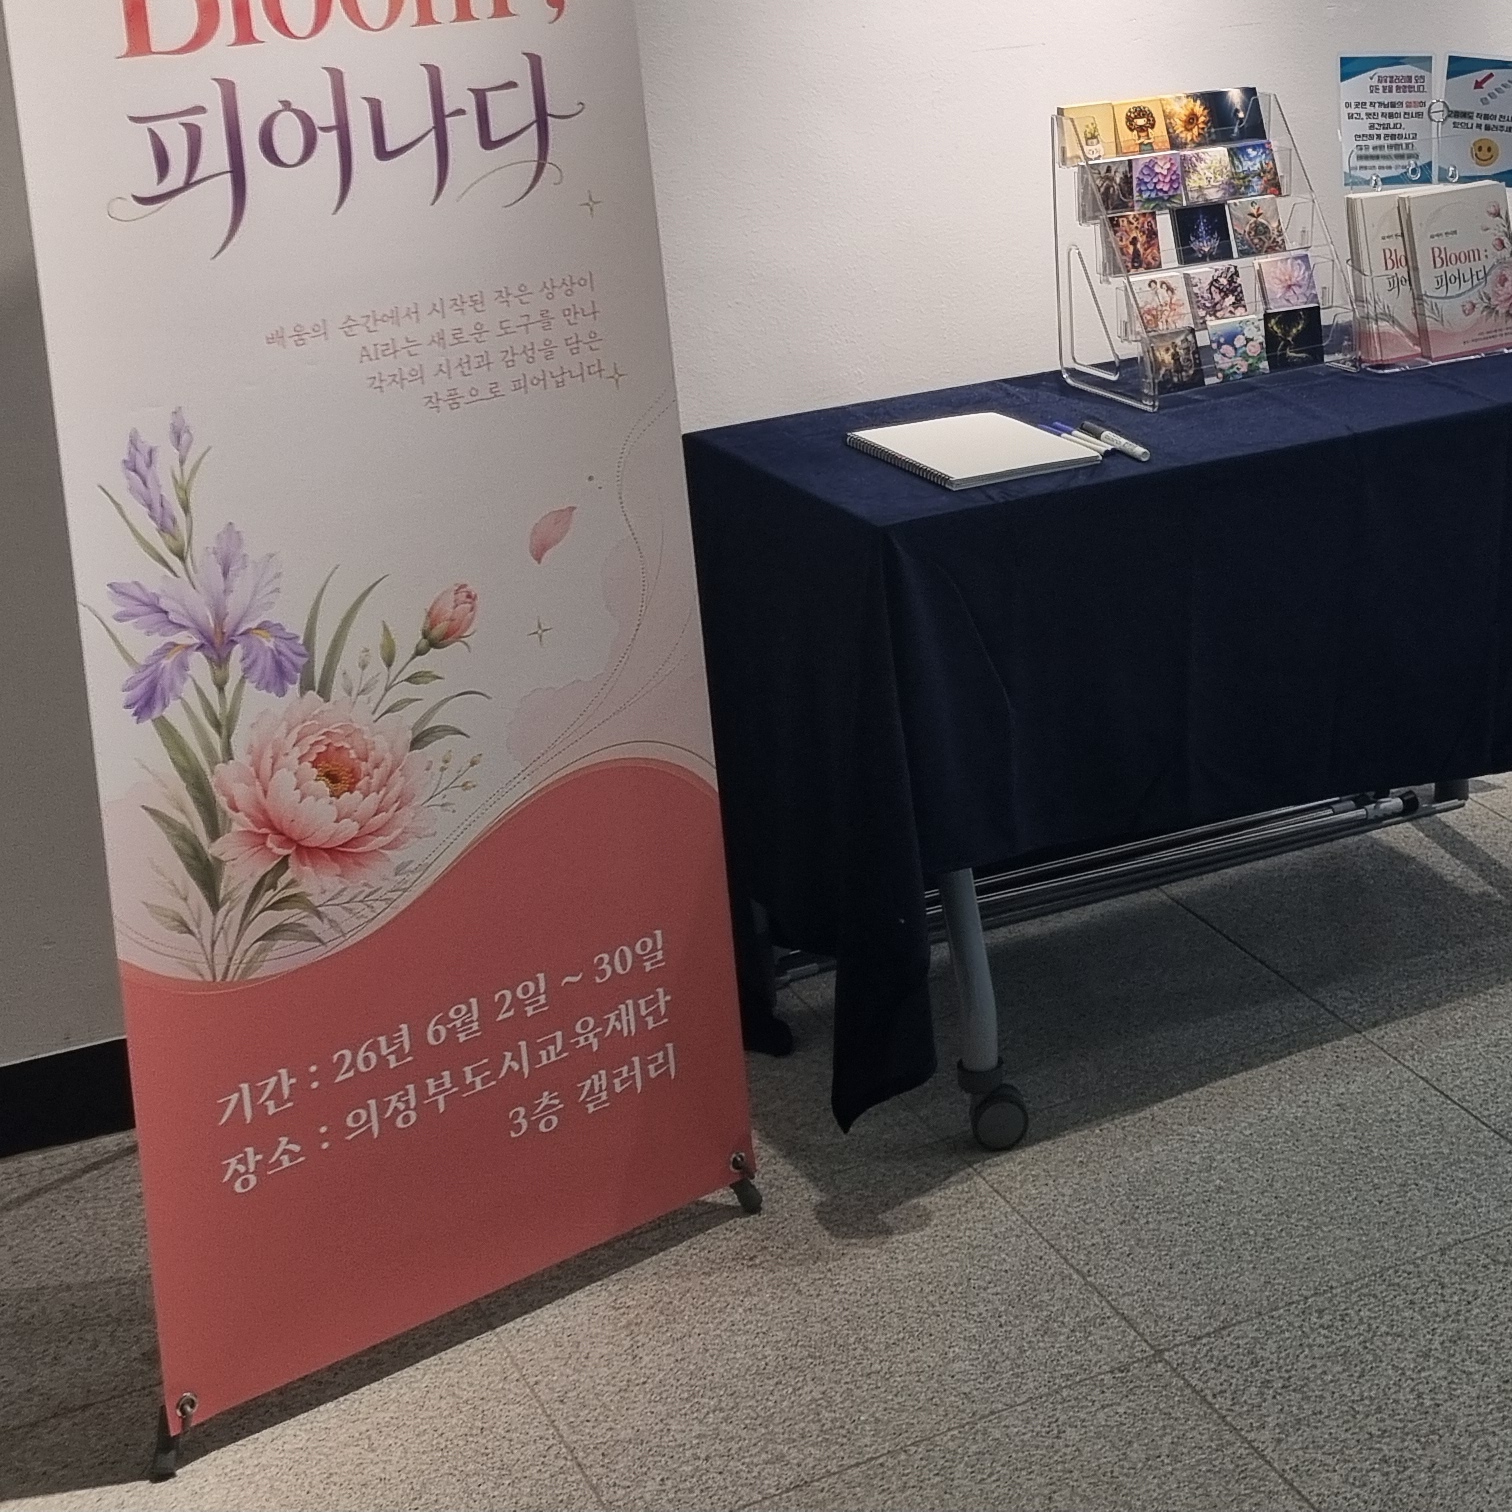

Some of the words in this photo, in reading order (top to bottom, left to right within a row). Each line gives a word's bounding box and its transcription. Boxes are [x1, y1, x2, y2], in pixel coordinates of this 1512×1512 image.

[1344, 101, 1352, 109] 이
[1381, 111, 1401, 120] 작품이
[125, 51, 586, 260] 피어나다
[1431, 246, 1481, 269] Bloom
[1434, 265, 1487, 296] 피어나다
[265, 319, 328, 349] 배움의
[338, 302, 420, 337] 순간에서
[427, 290, 486, 320] 시작된
[494, 283, 533, 306] 작은
[539, 271, 595, 300] 상상이
[358, 335, 423, 364] AI라는
[427, 322, 490, 347] 새로운
[495, 309, 556, 337] 도구를
[562, 300, 600, 326] 만나
[366, 363, 425, 393] 각자의
[433, 350, 494, 379] 시선과
[500, 339, 558, 368] 감성을
[564, 330, 603, 355] 담은
[423, 381, 506, 413] 작품으로
[511, 358, 606, 395] 피어납니다
[216, 1068, 296, 1127] 기간
[332, 1023, 414, 1084] 26년
[426, 997, 483, 1047] 6월
[494, 972, 550, 1022] 2일
[593, 929, 667, 986] 30일
[221, 1135, 306, 1195] 장소
[344, 987, 672, 1142] 의정부도시교육재단
[507, 1090, 564, 1139] 3층
[575, 1043, 678, 1116] 갤러리
